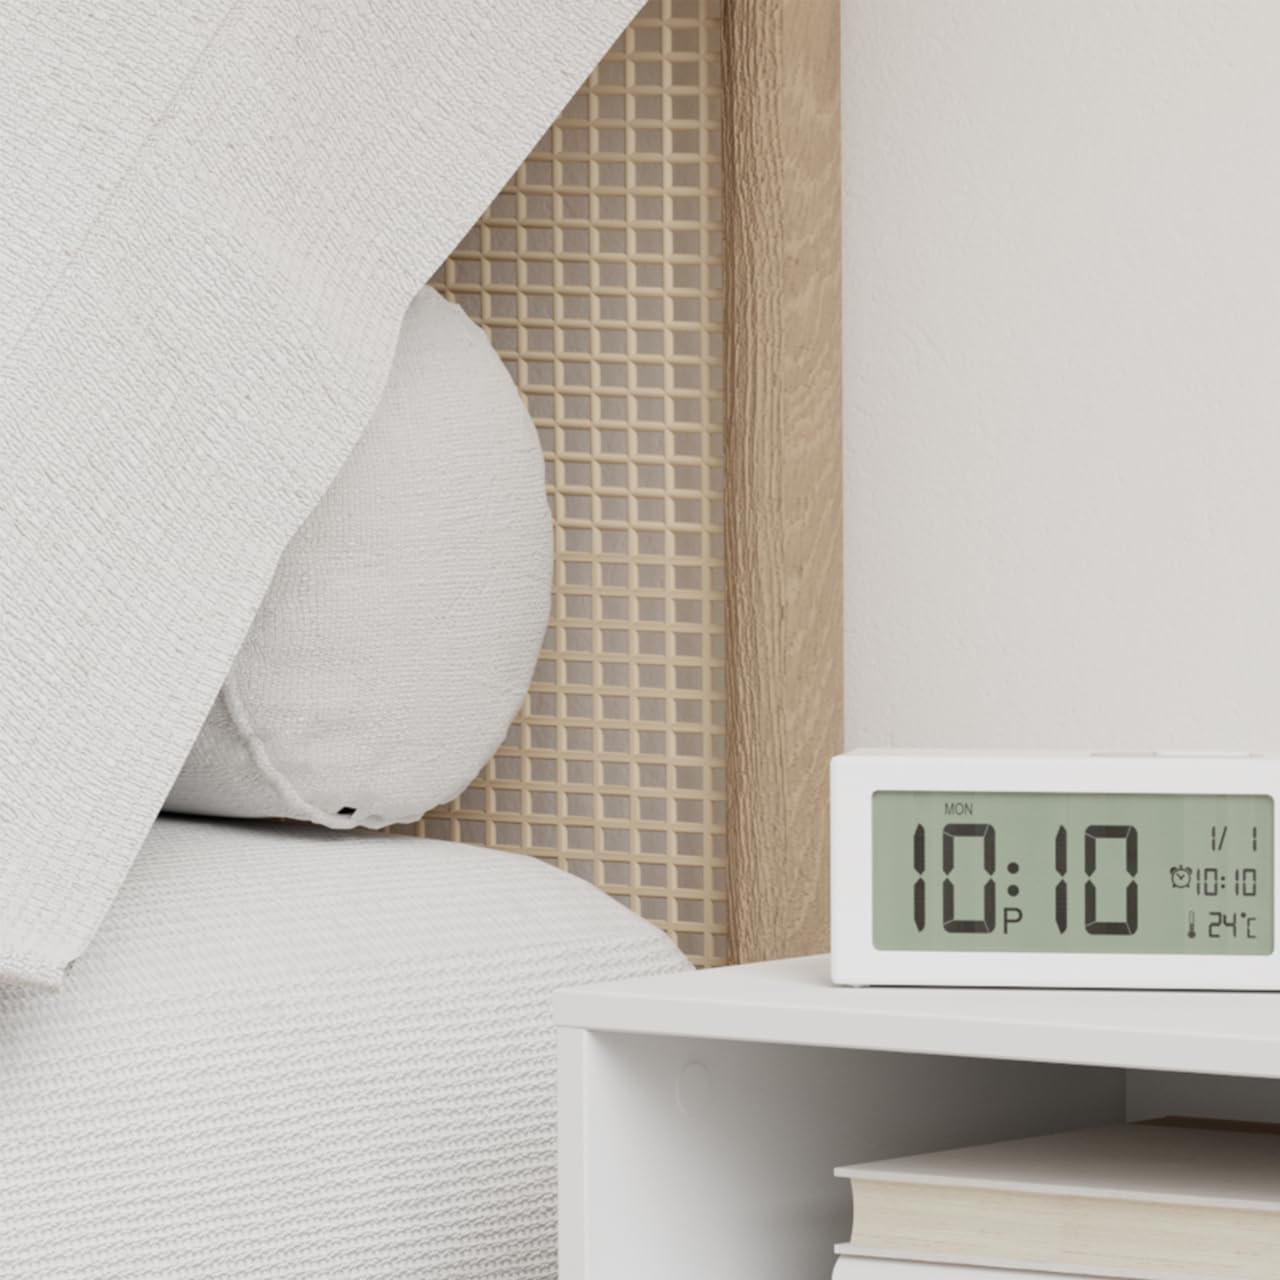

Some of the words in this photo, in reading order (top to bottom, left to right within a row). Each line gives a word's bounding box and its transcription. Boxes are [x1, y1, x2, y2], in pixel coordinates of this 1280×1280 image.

[944, 802, 974, 816] MON
[913, 823, 1139, 936] 10:10
[1196, 867, 1257, 897] 10:10
[1003, 907, 1023, 935] P
